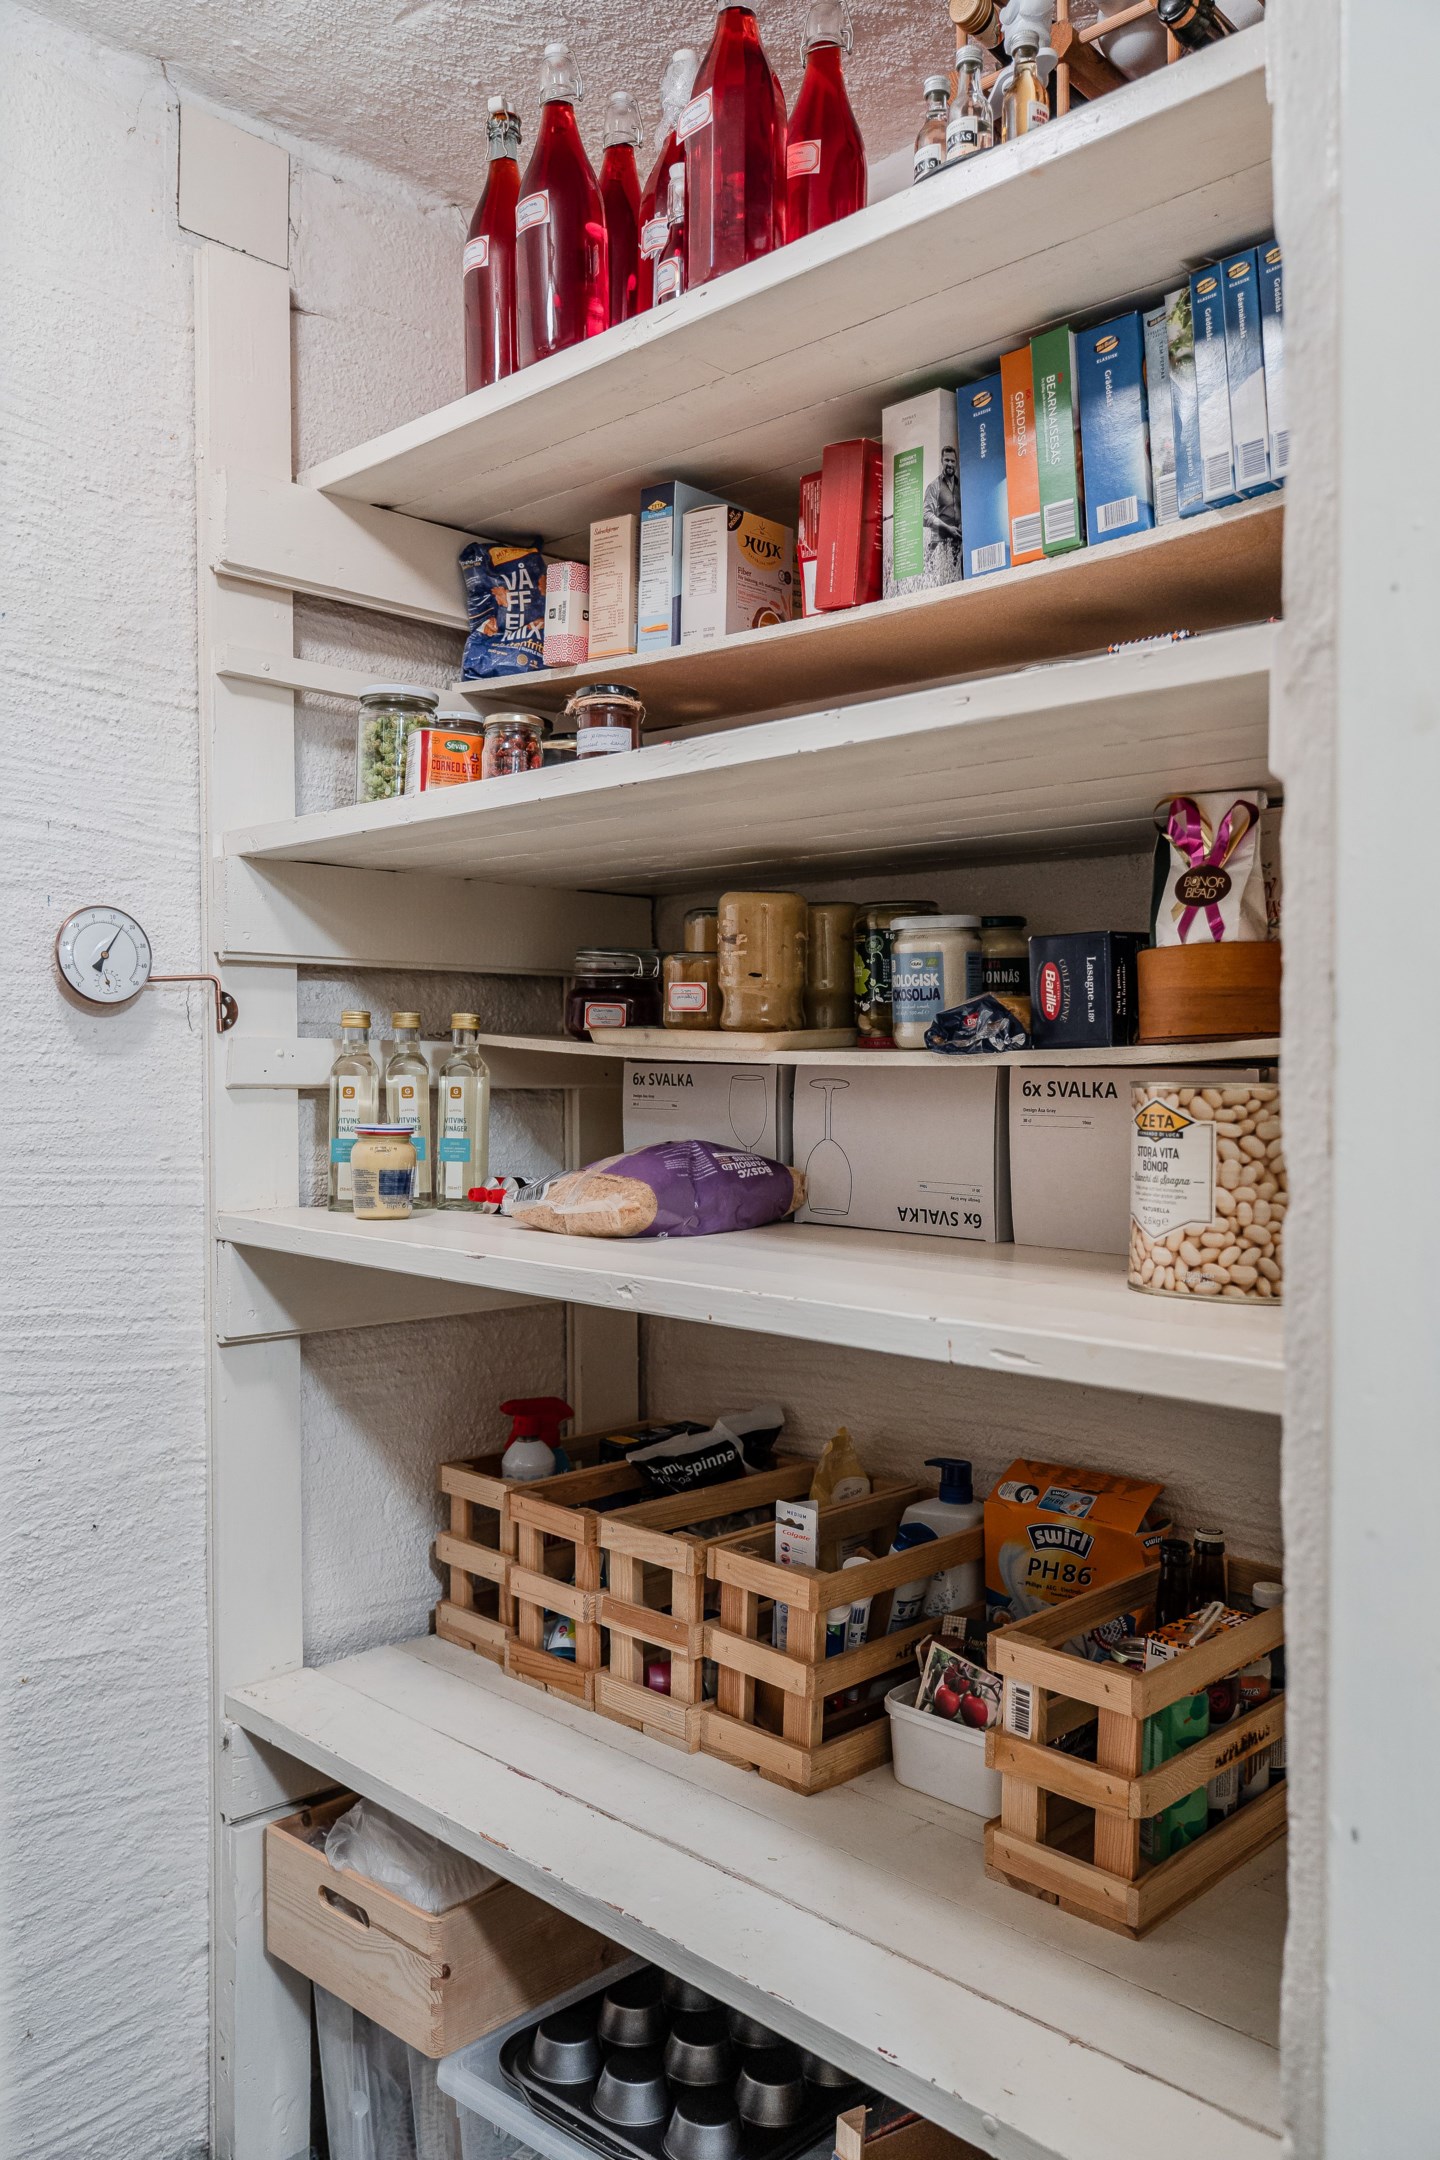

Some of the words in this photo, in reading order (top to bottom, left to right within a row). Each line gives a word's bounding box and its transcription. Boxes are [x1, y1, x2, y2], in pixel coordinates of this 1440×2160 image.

[1228, 276, 1250, 288] KLASSISK
[1197, 292, 1217, 303] KLASSISK
[1205, 307, 1213, 342] Gräddsås
[1096, 353, 1118, 364] KLASSISK
[979, 422, 988, 459] Gräddsås
[742, 534, 782, 560] HUSK
[500, 562, 534, 592] VÅ
[506, 590, 532, 612] FF
[500, 622, 545, 642] MIX
[446, 741, 468, 751] Sevan
[431, 759, 461, 773] CORNED
[892, 972, 940, 988] KOLOGISK
[983, 968, 1020, 984] ONNÄS
[1084, 956, 1096, 1001] Lasagne
[893, 987, 941, 1002] OKOSOLJA
[1045, 969, 1057, 1014] Barilla
[1058, 958, 1071, 1023] COLLEZIONE
[633, 1072, 646, 1085] 6x
[649, 1072, 694, 1087] SVALKA
[1022, 1080, 1042, 1097] 6x
[1047, 1080, 1118, 1099] SVALKA
[336, 1117, 361, 1125] VITVINS
[397, 1116, 421, 1124] VITVINS
[1141, 1113, 1175, 1129] ZETA
[444, 1125, 468, 1133] VINÄGER
[1137, 1145, 1158, 1158] STORA
[1160, 1147, 1180, 1160] VITA
[721, 1160, 767, 1171] PARBOILED
[1142, 1158, 1169, 1173] BÖNOR
[1160, 1176, 1191, 1188] Spagna
[897, 1206, 959, 1227] SVALKA
[963, 1212, 982, 1229] 6x
[786, 1510, 807, 1520] MEDIUM
[782, 1529, 811, 1541] Colgate
[1034, 1528, 1089, 1552] swirl
[1145, 1536, 1164, 1548] swirl
[1118, 1616, 1128, 1632] PLUS
